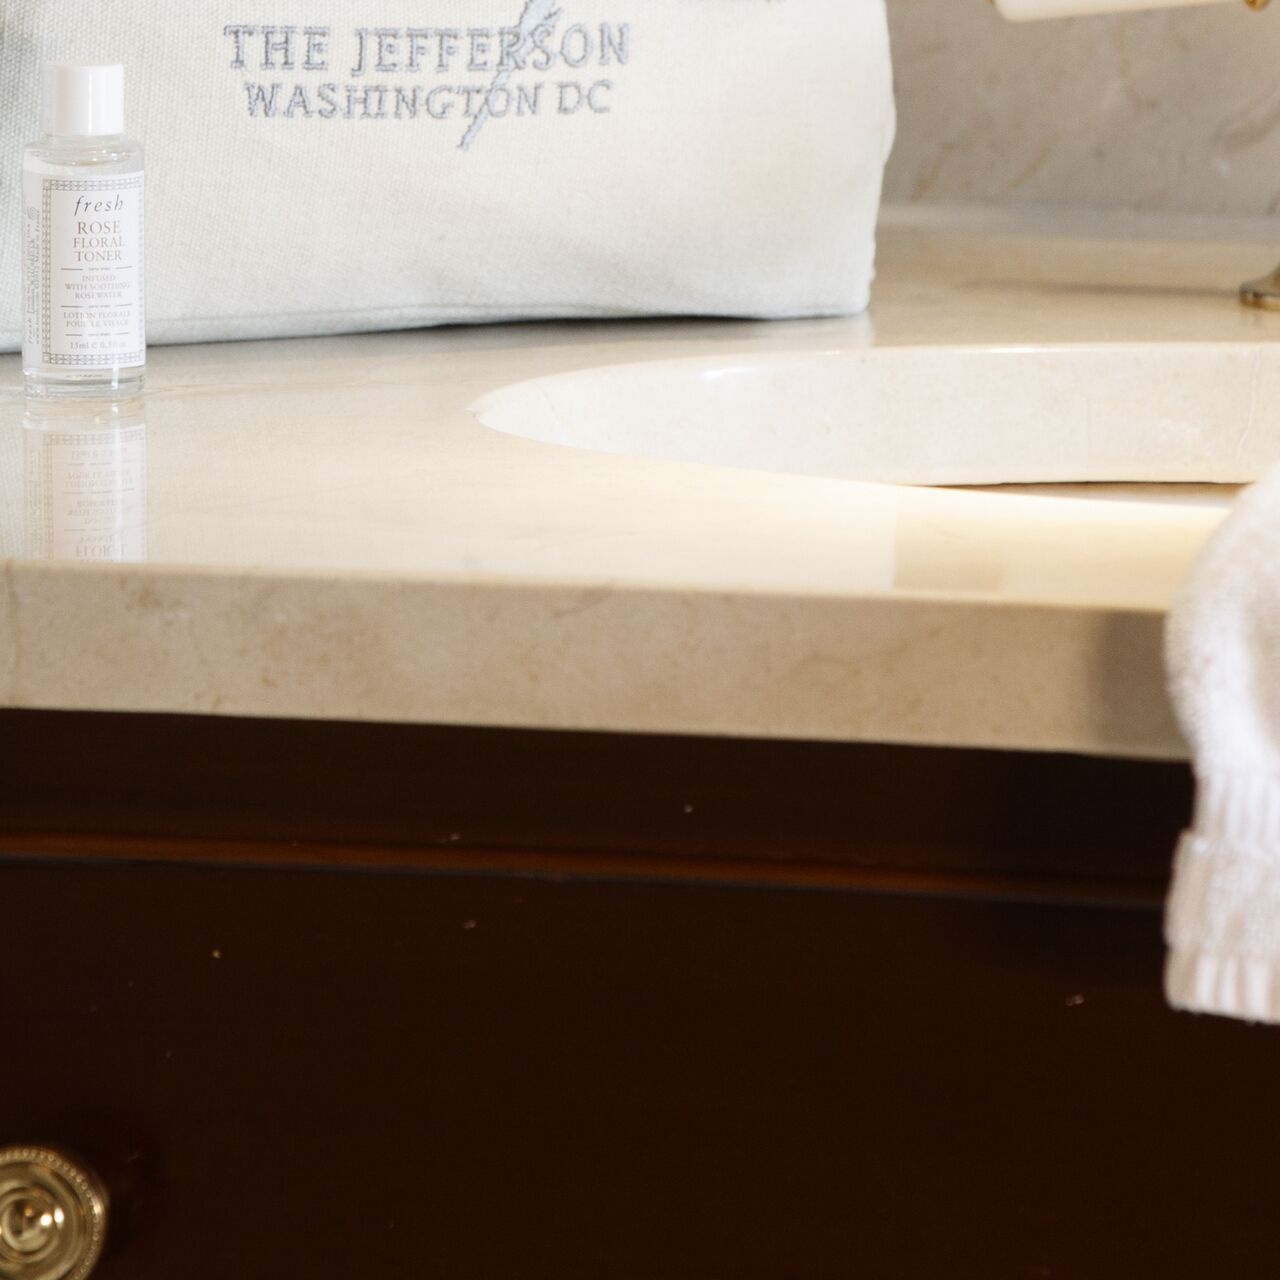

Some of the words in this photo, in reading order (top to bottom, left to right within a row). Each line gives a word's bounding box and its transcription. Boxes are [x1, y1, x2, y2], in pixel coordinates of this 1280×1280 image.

[223, 23, 331, 72] THE
[350, 22, 632, 78] JEFFERSON
[244, 80, 544, 120] WASHINGTON
[555, 79, 615, 116] DC
[73, 194, 124, 217] fresh
[77, 220, 122, 235] ROSE
[73, 235, 125, 249] FLORAL
[74, 250, 122, 262] TONER
